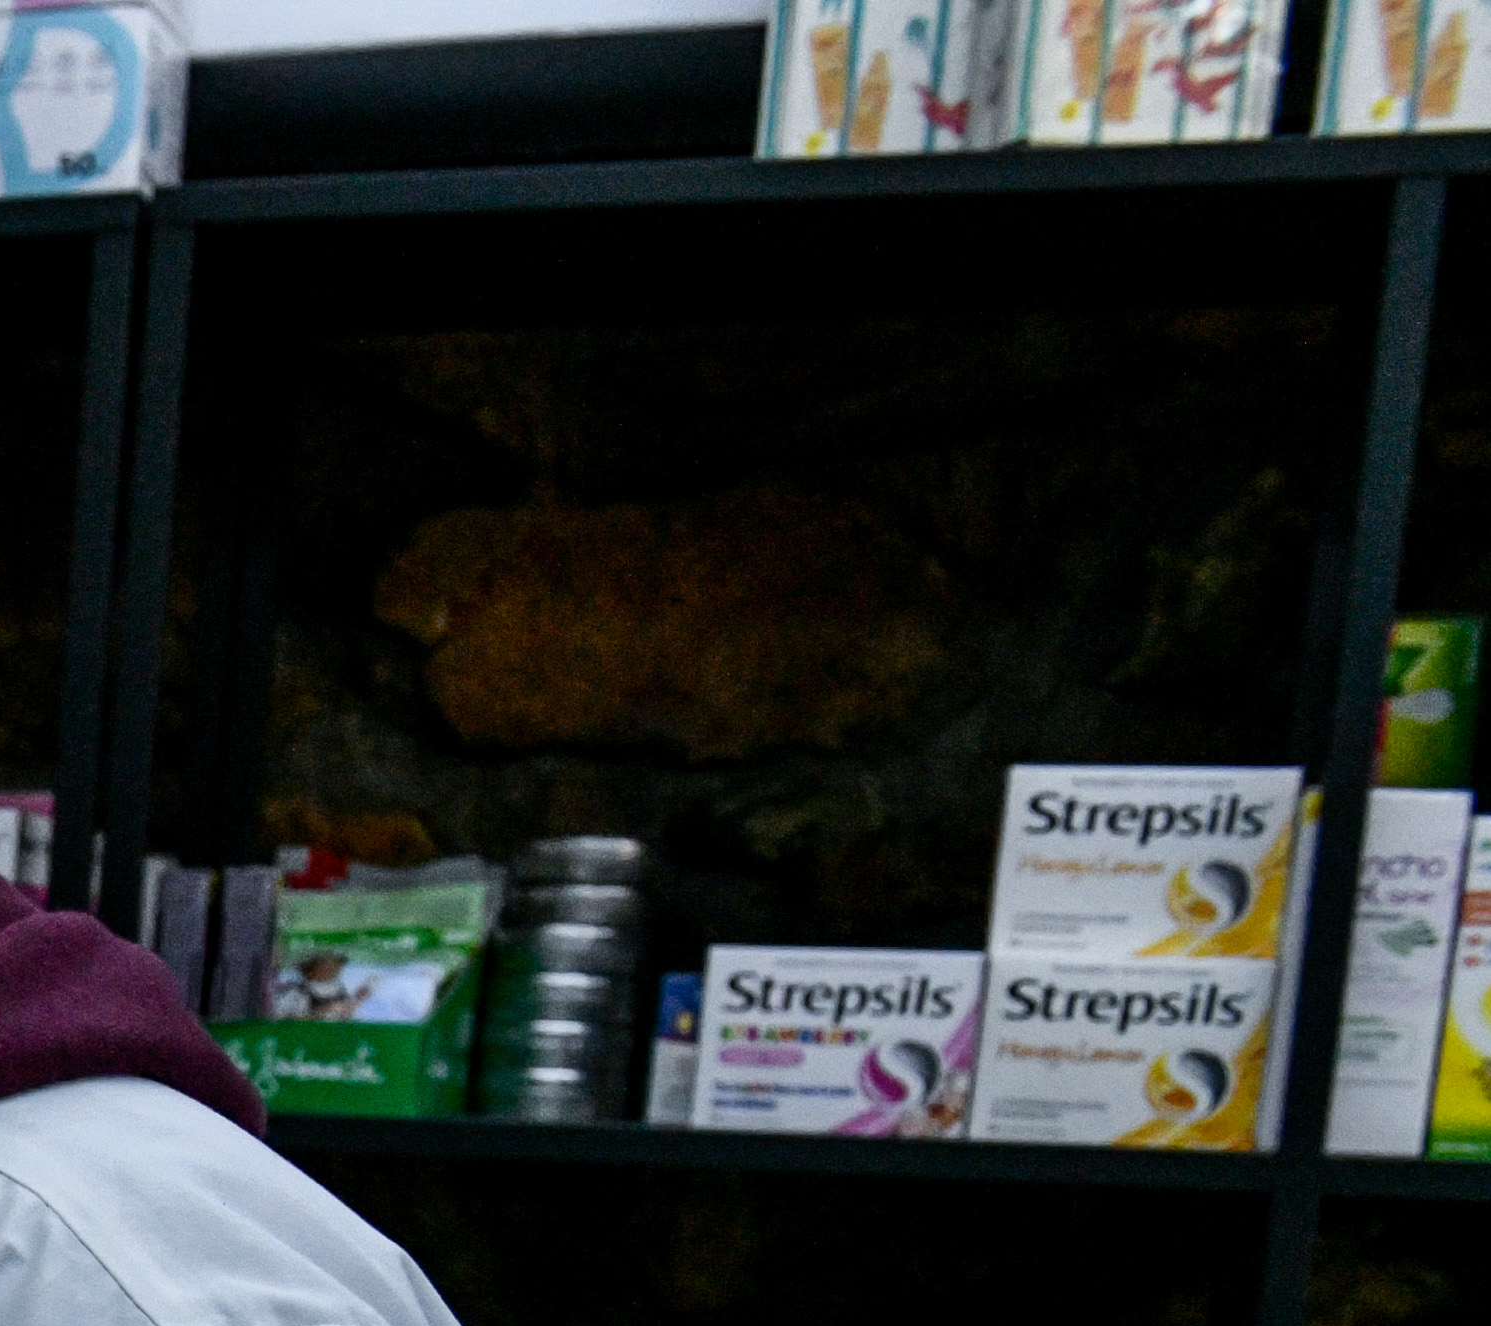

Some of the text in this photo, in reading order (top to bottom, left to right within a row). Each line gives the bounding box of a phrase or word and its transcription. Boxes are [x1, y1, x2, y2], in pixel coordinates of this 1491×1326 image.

[1026, 789, 1266, 846] Strepsils
[728, 970, 954, 1023] Strepsils
[1005, 978, 1245, 1034] Strepsils
